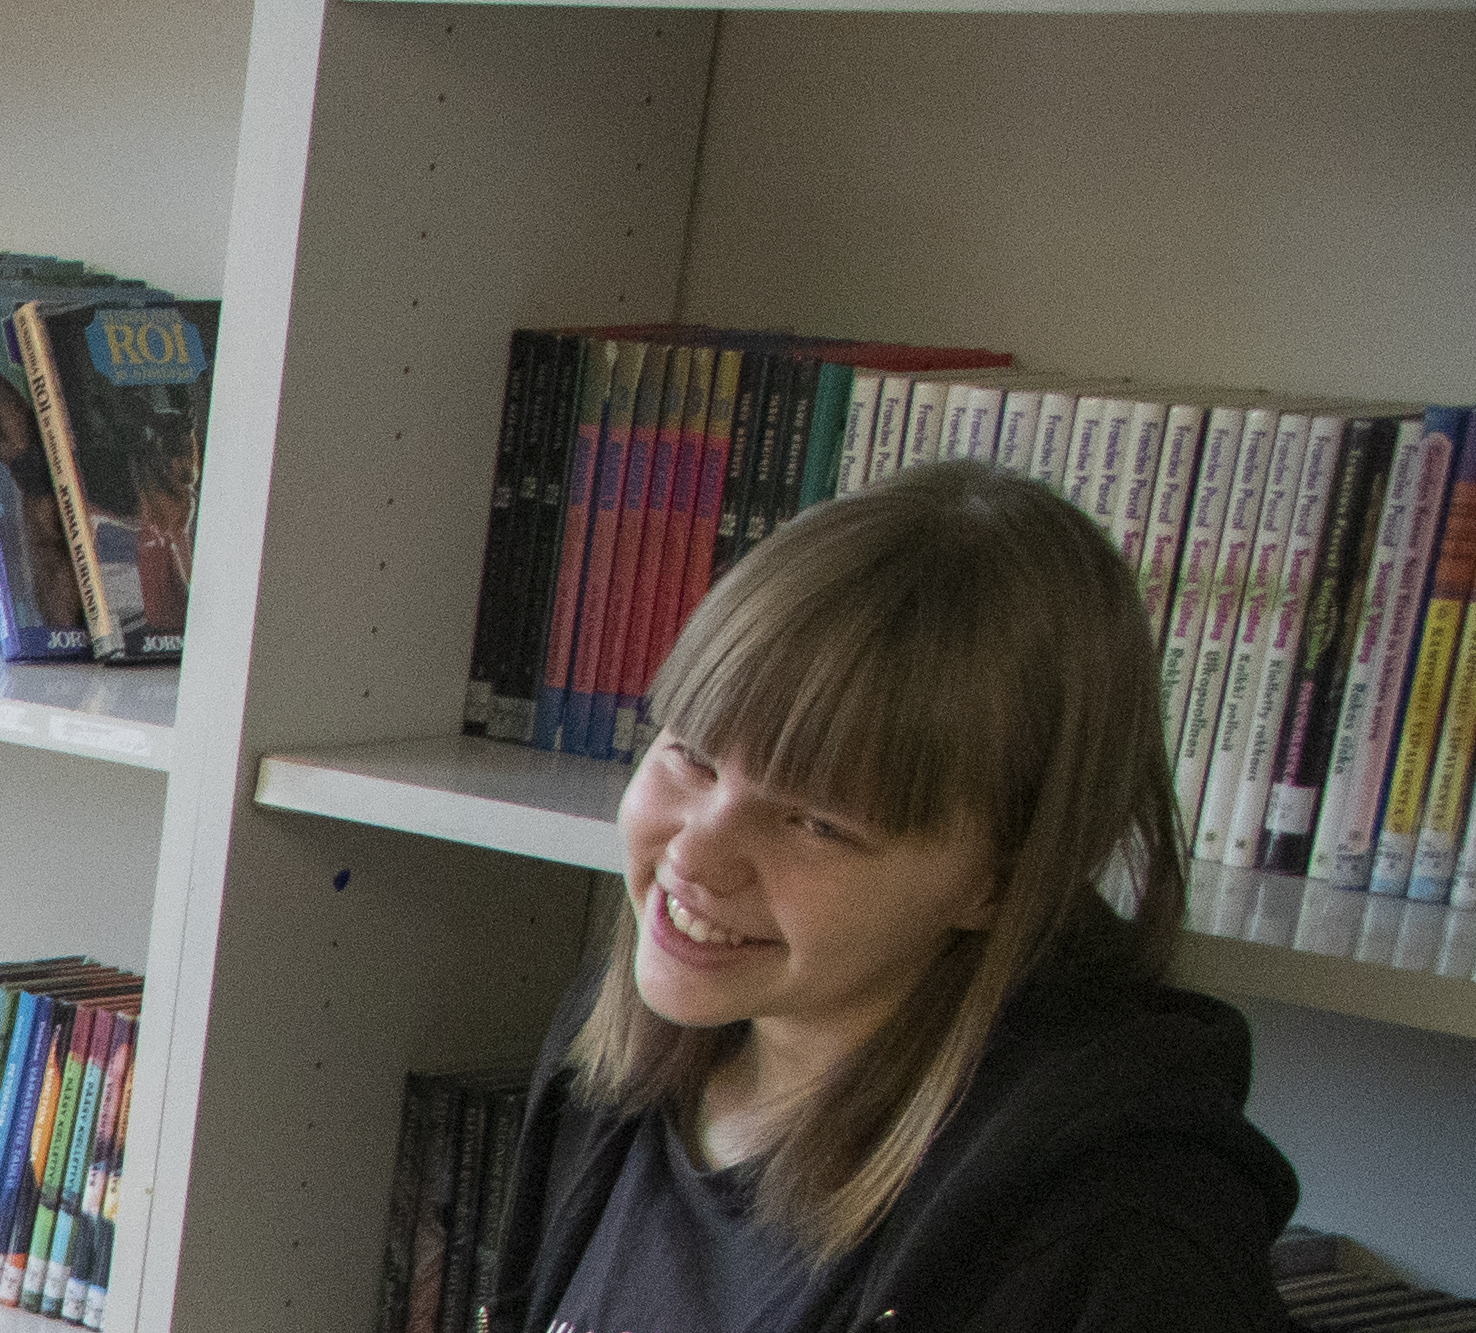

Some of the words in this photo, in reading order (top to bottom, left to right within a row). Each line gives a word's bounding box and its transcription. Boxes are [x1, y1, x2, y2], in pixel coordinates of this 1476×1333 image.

[104, 323, 190, 366] ROI
[29, 374, 53, 415] ROI
[56, 483, 81, 538] JORMA
